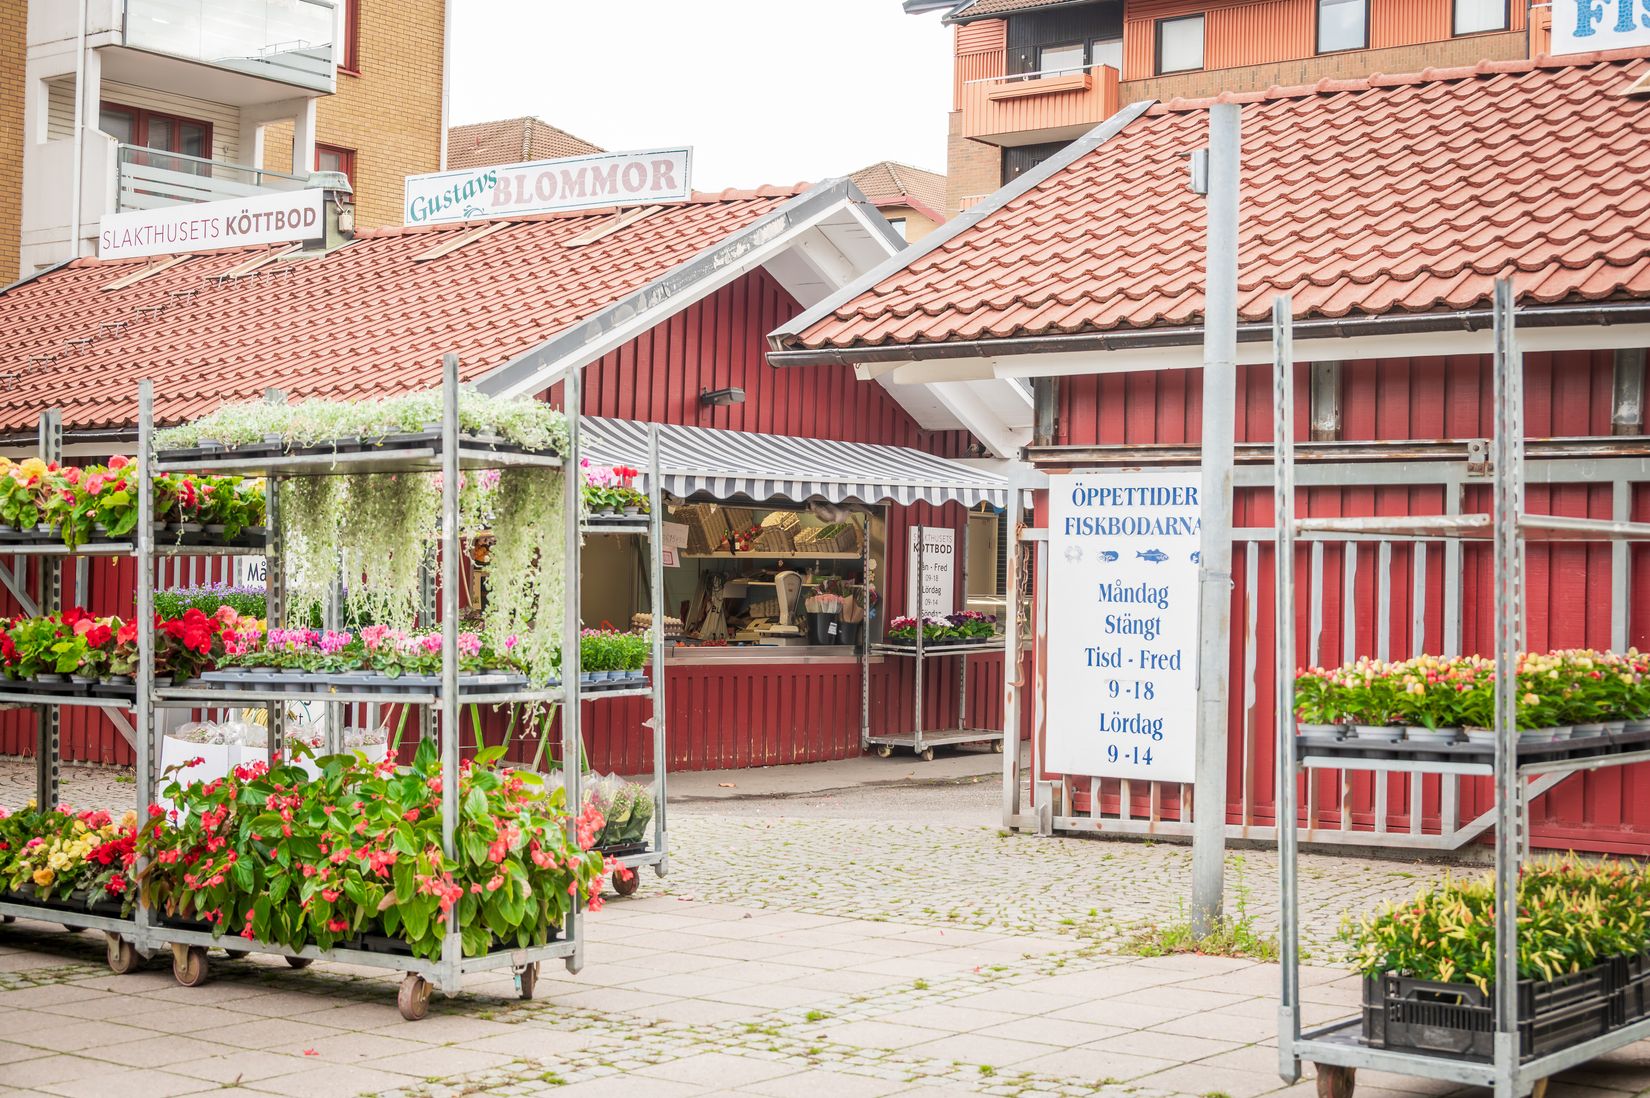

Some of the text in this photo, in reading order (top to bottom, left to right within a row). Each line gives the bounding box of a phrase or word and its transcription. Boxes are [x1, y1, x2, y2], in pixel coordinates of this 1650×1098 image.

[410, 167, 498, 223] Gustavs
[491, 158, 678, 208] BLOMMOR
[102, 207, 317, 250] SLAKTHUSETS KÖTTBOD
[1071, 482, 1199, 507] ÖPPETTIDER
[913, 533, 953, 544] SKTHUSETS
[1064, 516, 1202, 536] FISKBODARNA
[247, 560, 267, 582] Må
[934, 562, 948, 572] Fred
[921, 585, 942, 597] Lördag
[1098, 578, 1169, 610] Måndag
[1104, 613, 1161, 641] Stängt
[1084, 646, 1122, 669] Tisd
[1139, 648, 1182, 671] Fred
[1099, 711, 1163, 741] Lördag
